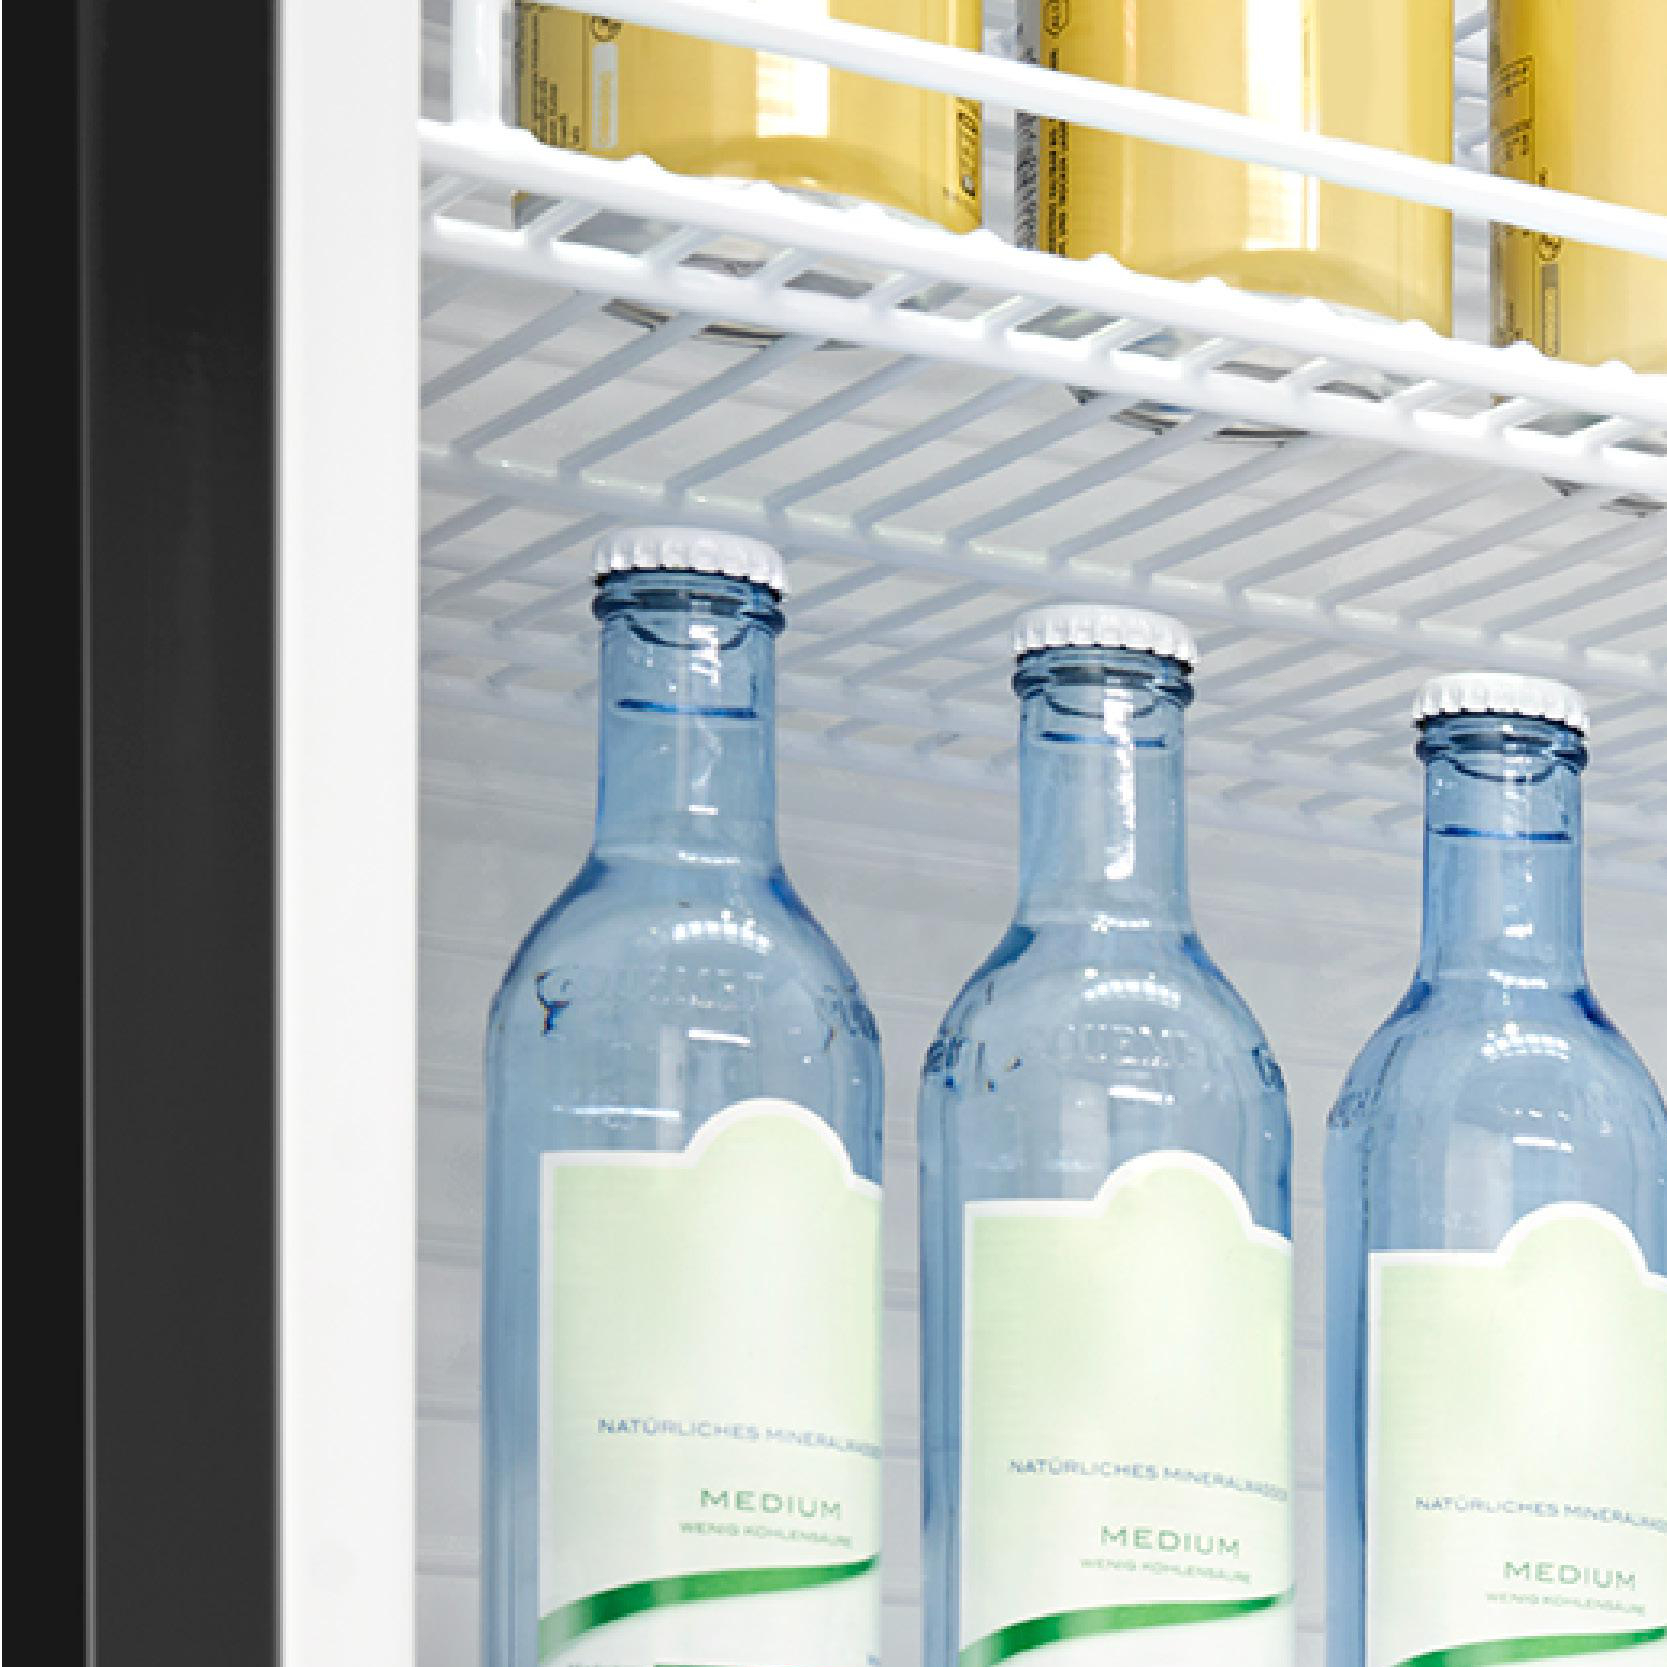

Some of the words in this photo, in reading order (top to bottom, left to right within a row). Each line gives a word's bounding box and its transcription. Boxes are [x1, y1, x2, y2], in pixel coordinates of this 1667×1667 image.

[597, 1417, 759, 1440] NATÜRLICHES
[1009, 1456, 1158, 1481] NATÜRLICHES
[700, 1487, 842, 1520] MEDIUM
[1415, 1495, 1559, 1517] NATÜRLICHES
[1100, 1525, 1241, 1559] MEDIUM
[1502, 1561, 1636, 1591] MEDIUM
